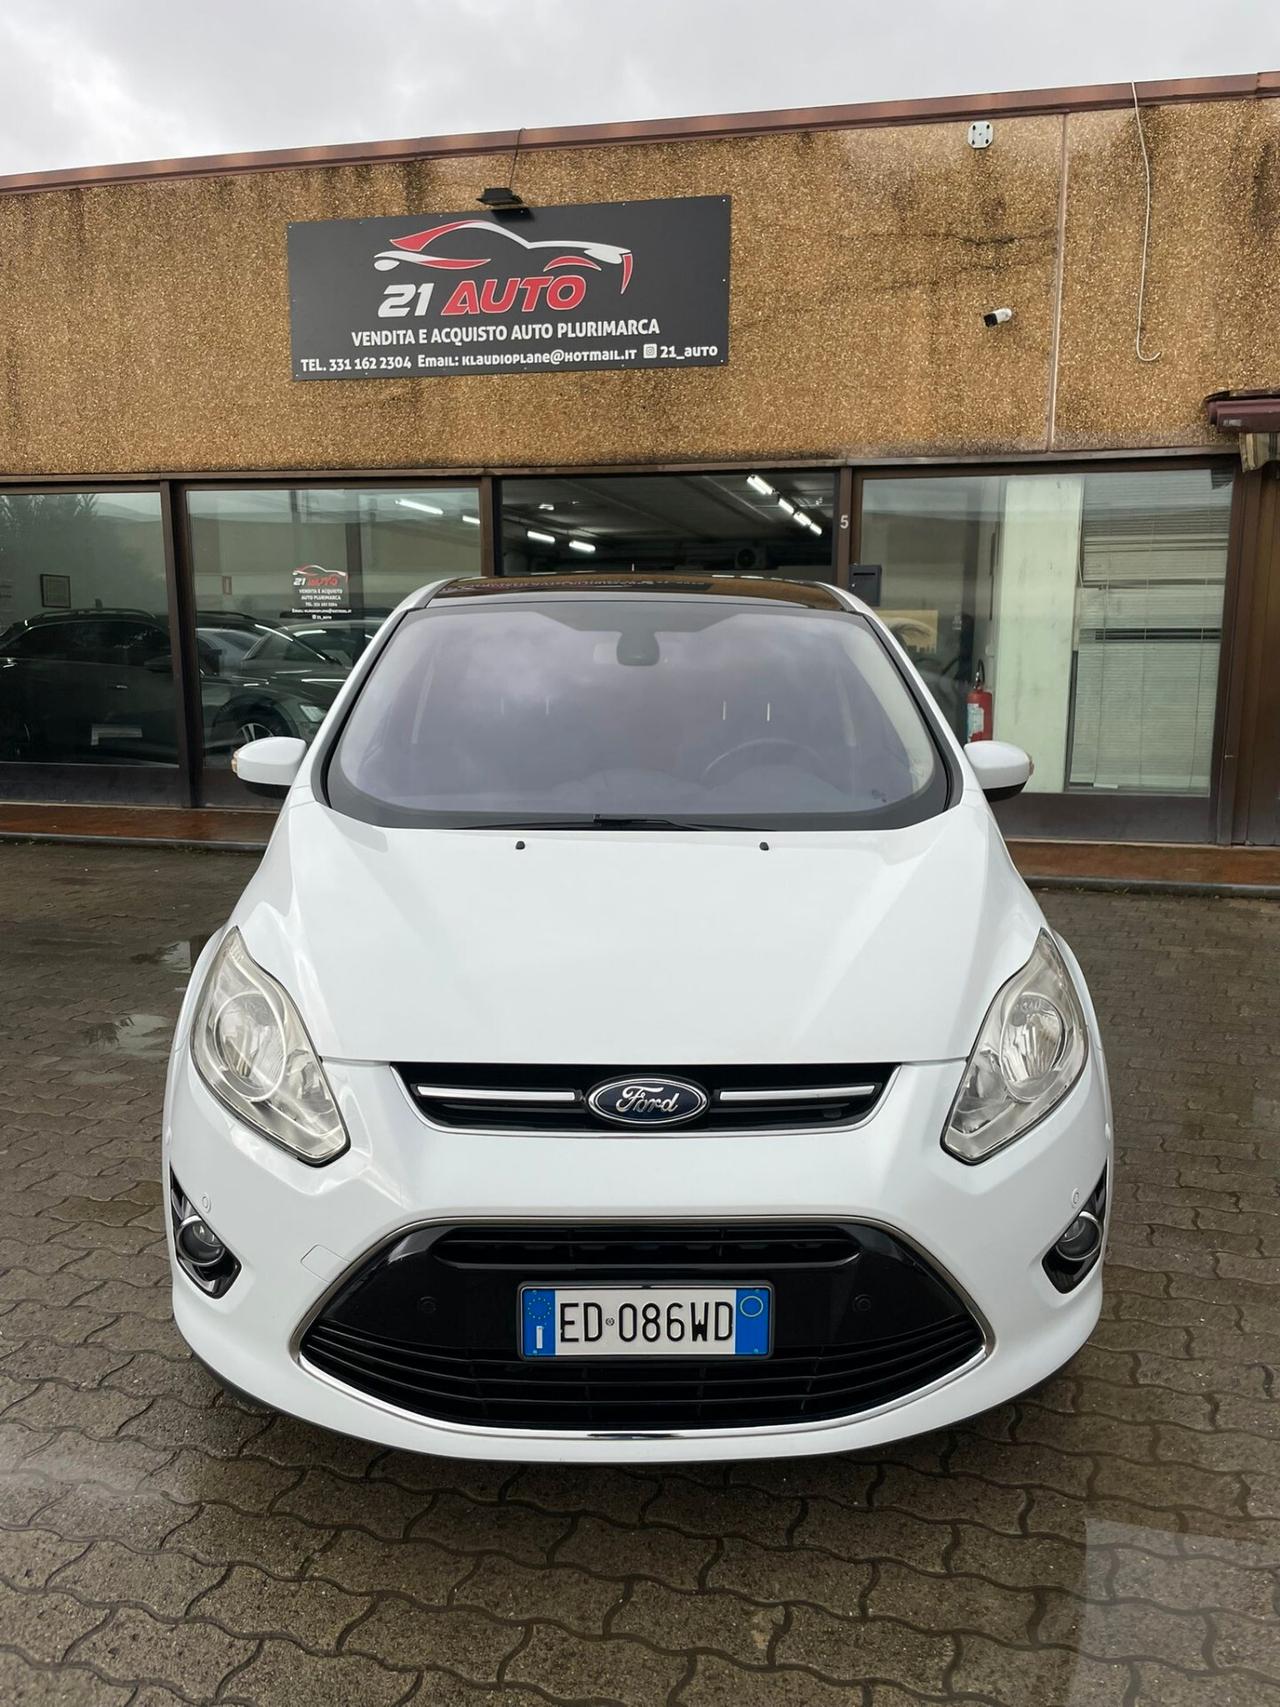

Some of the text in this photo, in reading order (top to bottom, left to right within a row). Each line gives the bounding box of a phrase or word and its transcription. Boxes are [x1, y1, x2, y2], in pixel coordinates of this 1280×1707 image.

[377, 275, 587, 318] 21 AUTO
[351, 318, 660, 347] VENDITA E ACQUISTO AUTO PLURIMARCA
[300, 358, 327, 372] TEL.
[329, 358, 352, 371] 331
[354, 357, 377, 370] 162
[379, 356, 412, 370] 2304
[840, 514, 849, 529] 5
[293, 577, 306, 586] 21
[615, 1085, 679, 1112] Ford
